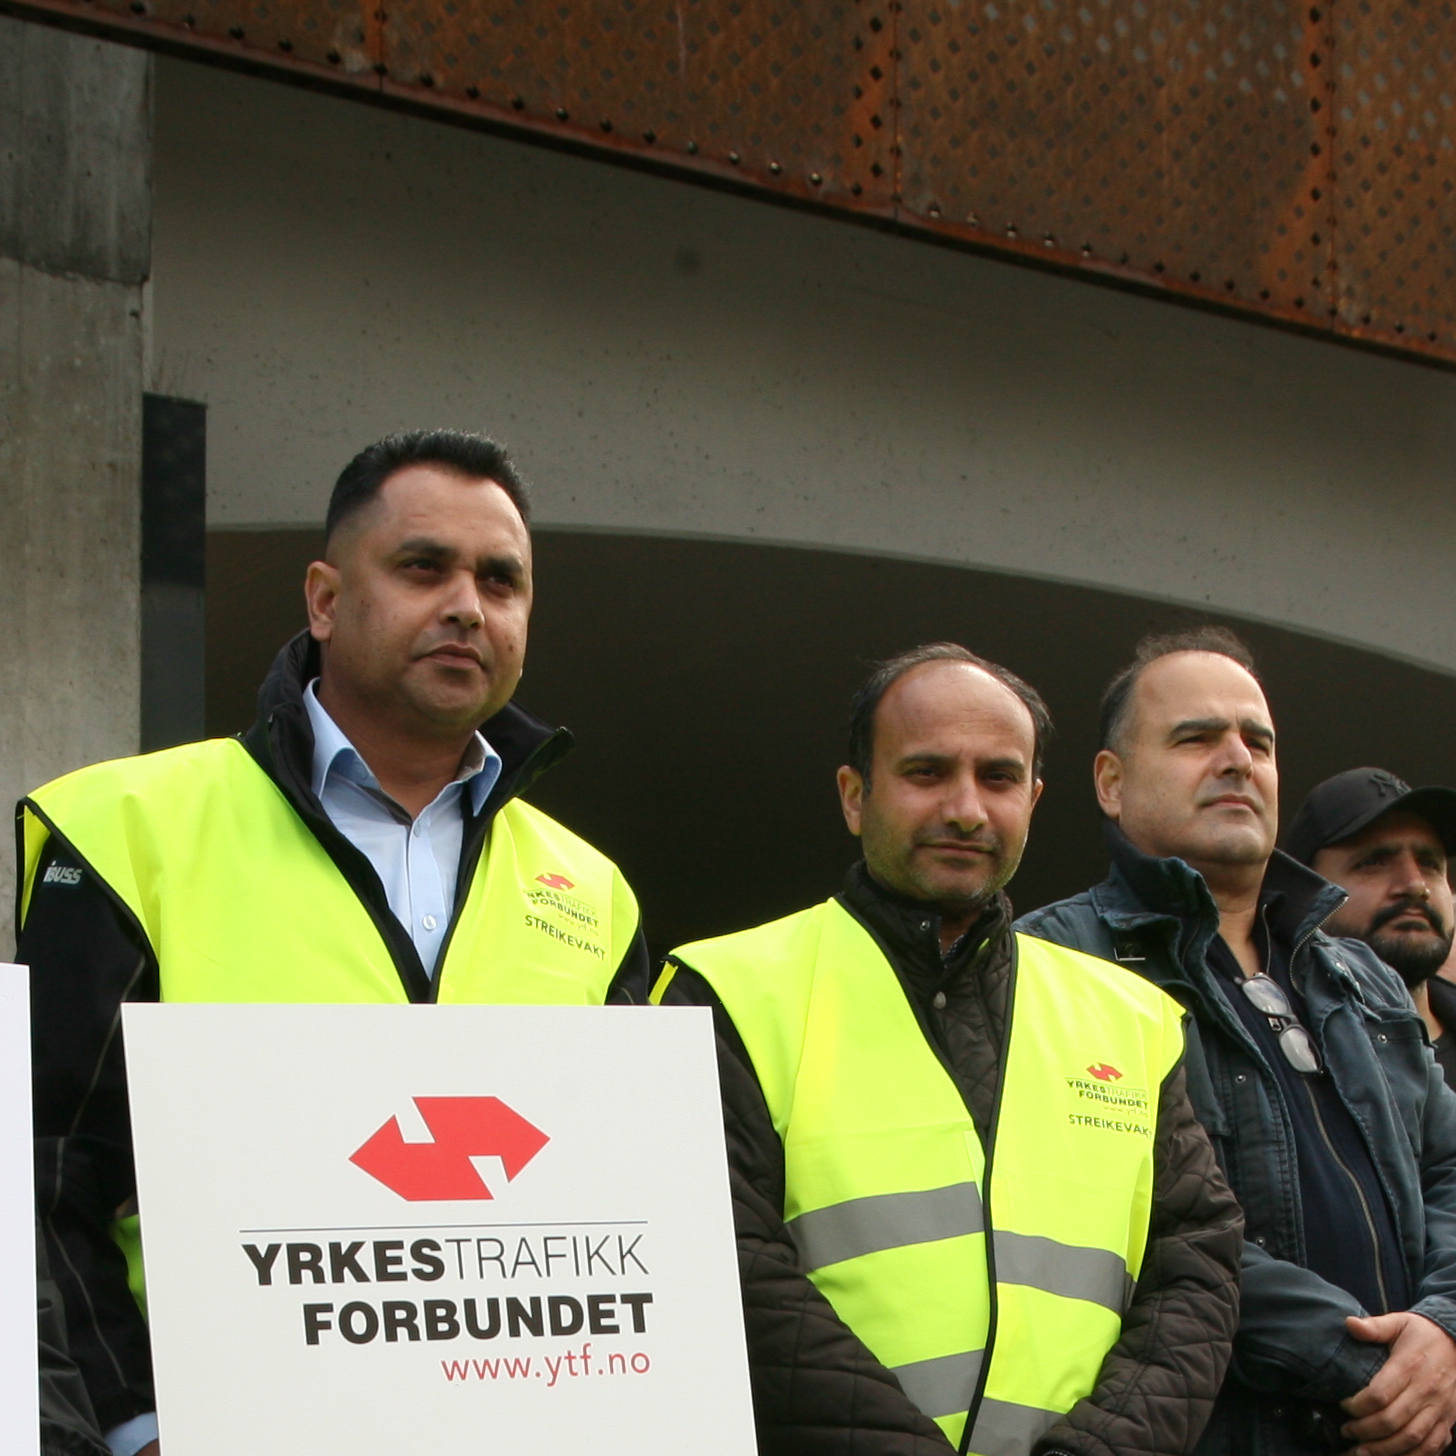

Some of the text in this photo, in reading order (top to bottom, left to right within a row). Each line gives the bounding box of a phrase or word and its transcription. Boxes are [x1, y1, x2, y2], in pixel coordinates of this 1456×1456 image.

[525, 914, 606, 961] STREIKEVAKT
[1079, 1090, 1149, 1110] FORBUNDET
[241, 1235, 650, 1286] YRKESTRAFIKK
[303, 1293, 654, 1346] FORBUNDET
[441, 1343, 651, 1388] www.ytf.no
